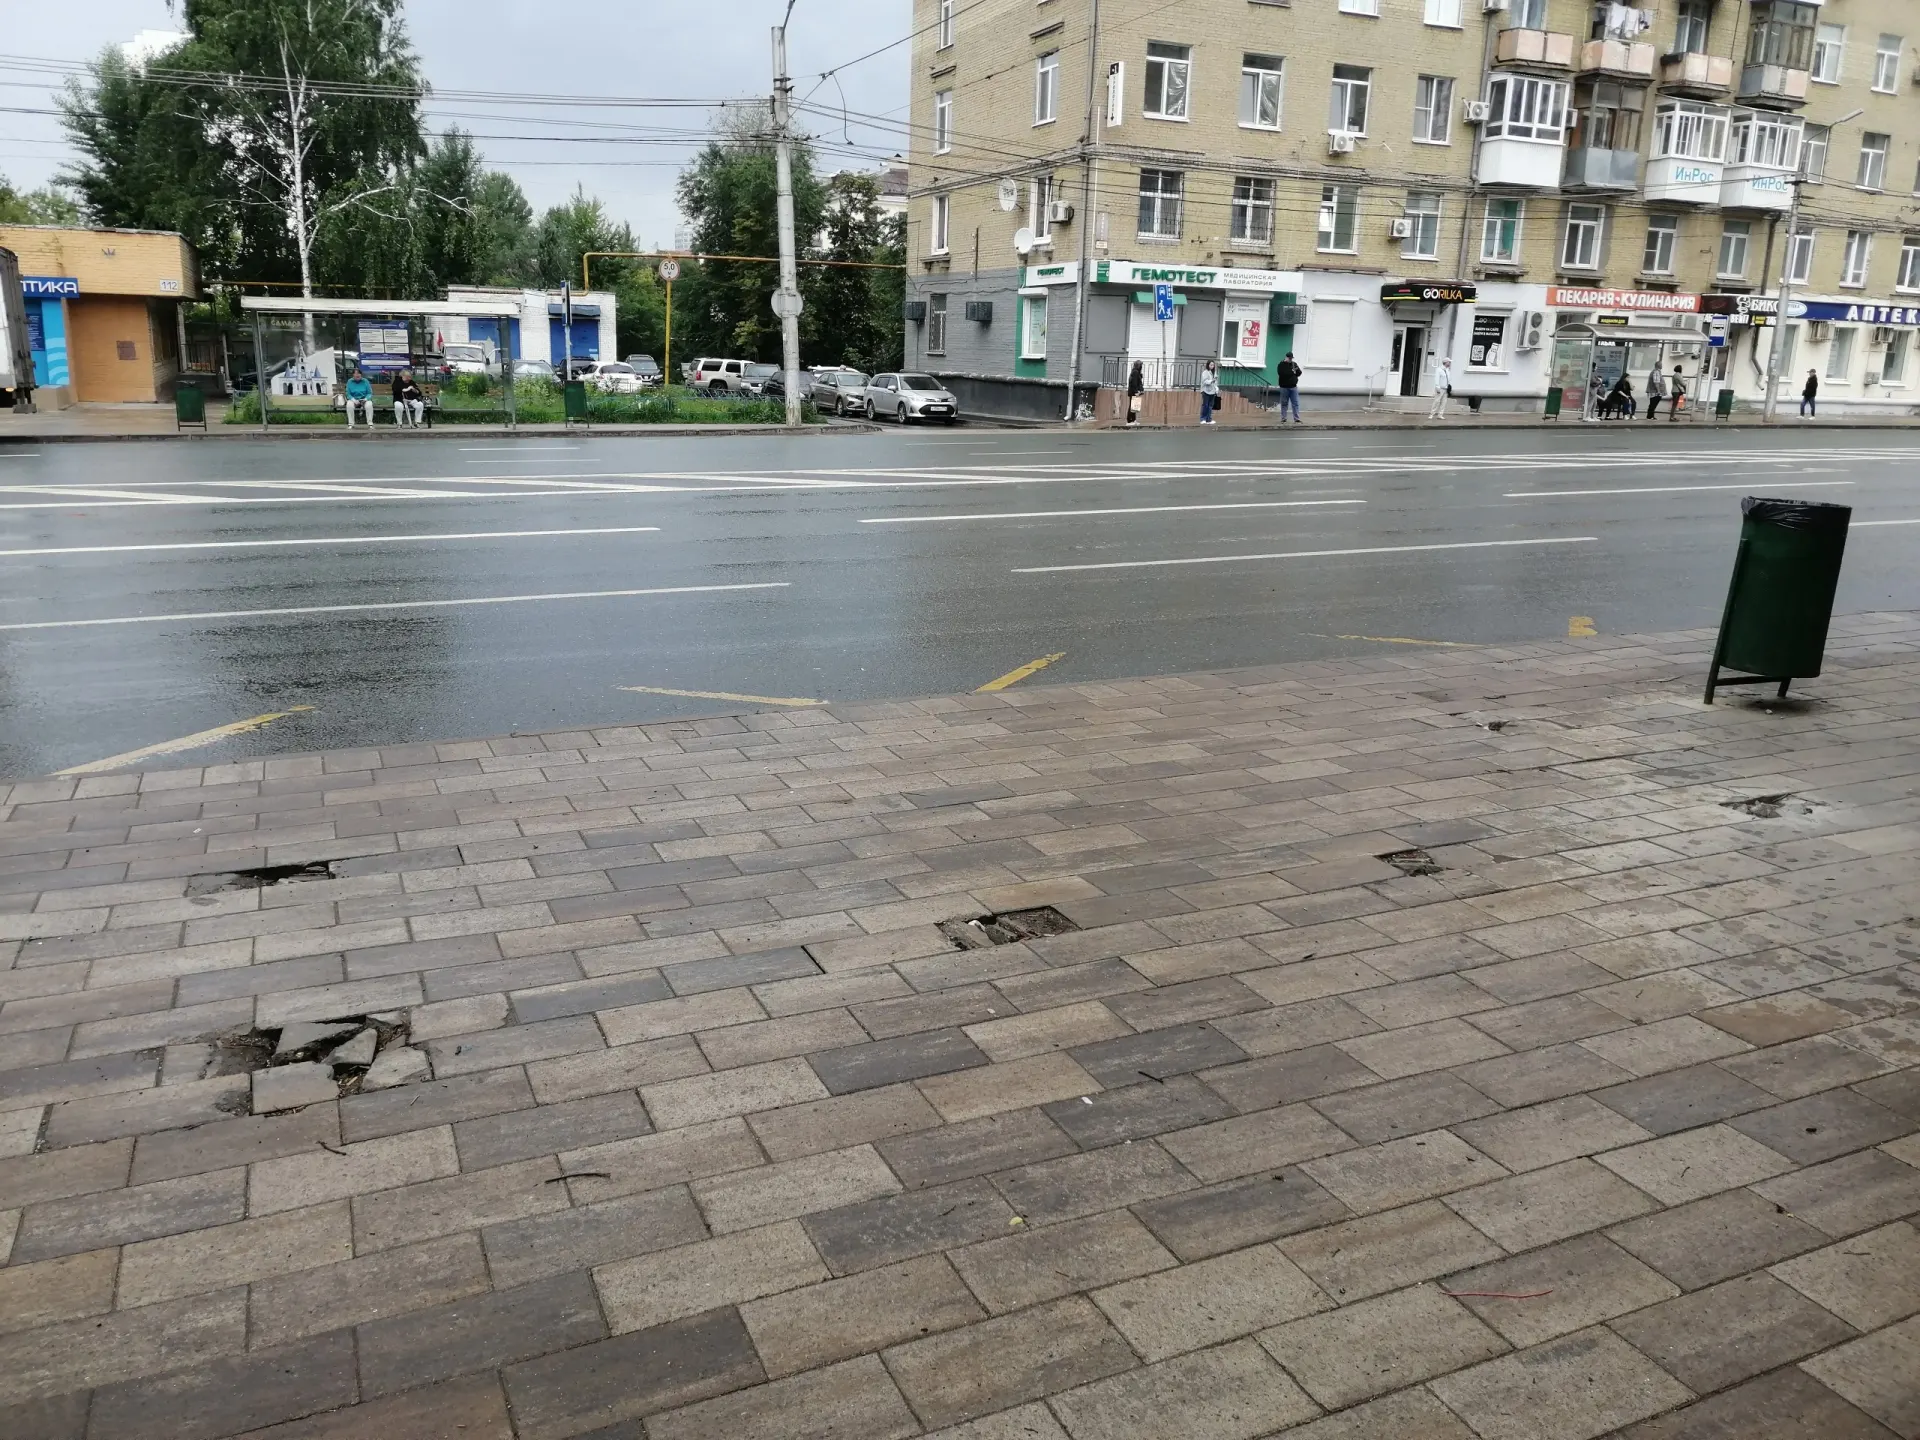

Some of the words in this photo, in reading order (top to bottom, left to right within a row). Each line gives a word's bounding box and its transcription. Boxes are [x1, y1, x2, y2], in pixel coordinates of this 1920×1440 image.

[1675, 166, 1714, 183] ИнРос
[1752, 175, 1788, 191] ИнРос
[1131, 267, 1217, 284] ГЕМОТЕСТ
[1223, 272, 1277, 281] МЕДИЦИНСКАЯ
[161, 281, 178, 291] 112
[1223, 279, 1273, 287] ЛАБОРАТОРИЯ
[1423, 287, 1463, 300] GORILKA
[1556, 289, 1615, 306] ПЕКАРНЯ
[1620, 293, 1696, 310] КУЛИНАРИЯ
[1845, 305, 1920, 324] АПТЕК
[1243, 338, 1257, 346] ЭКГ
